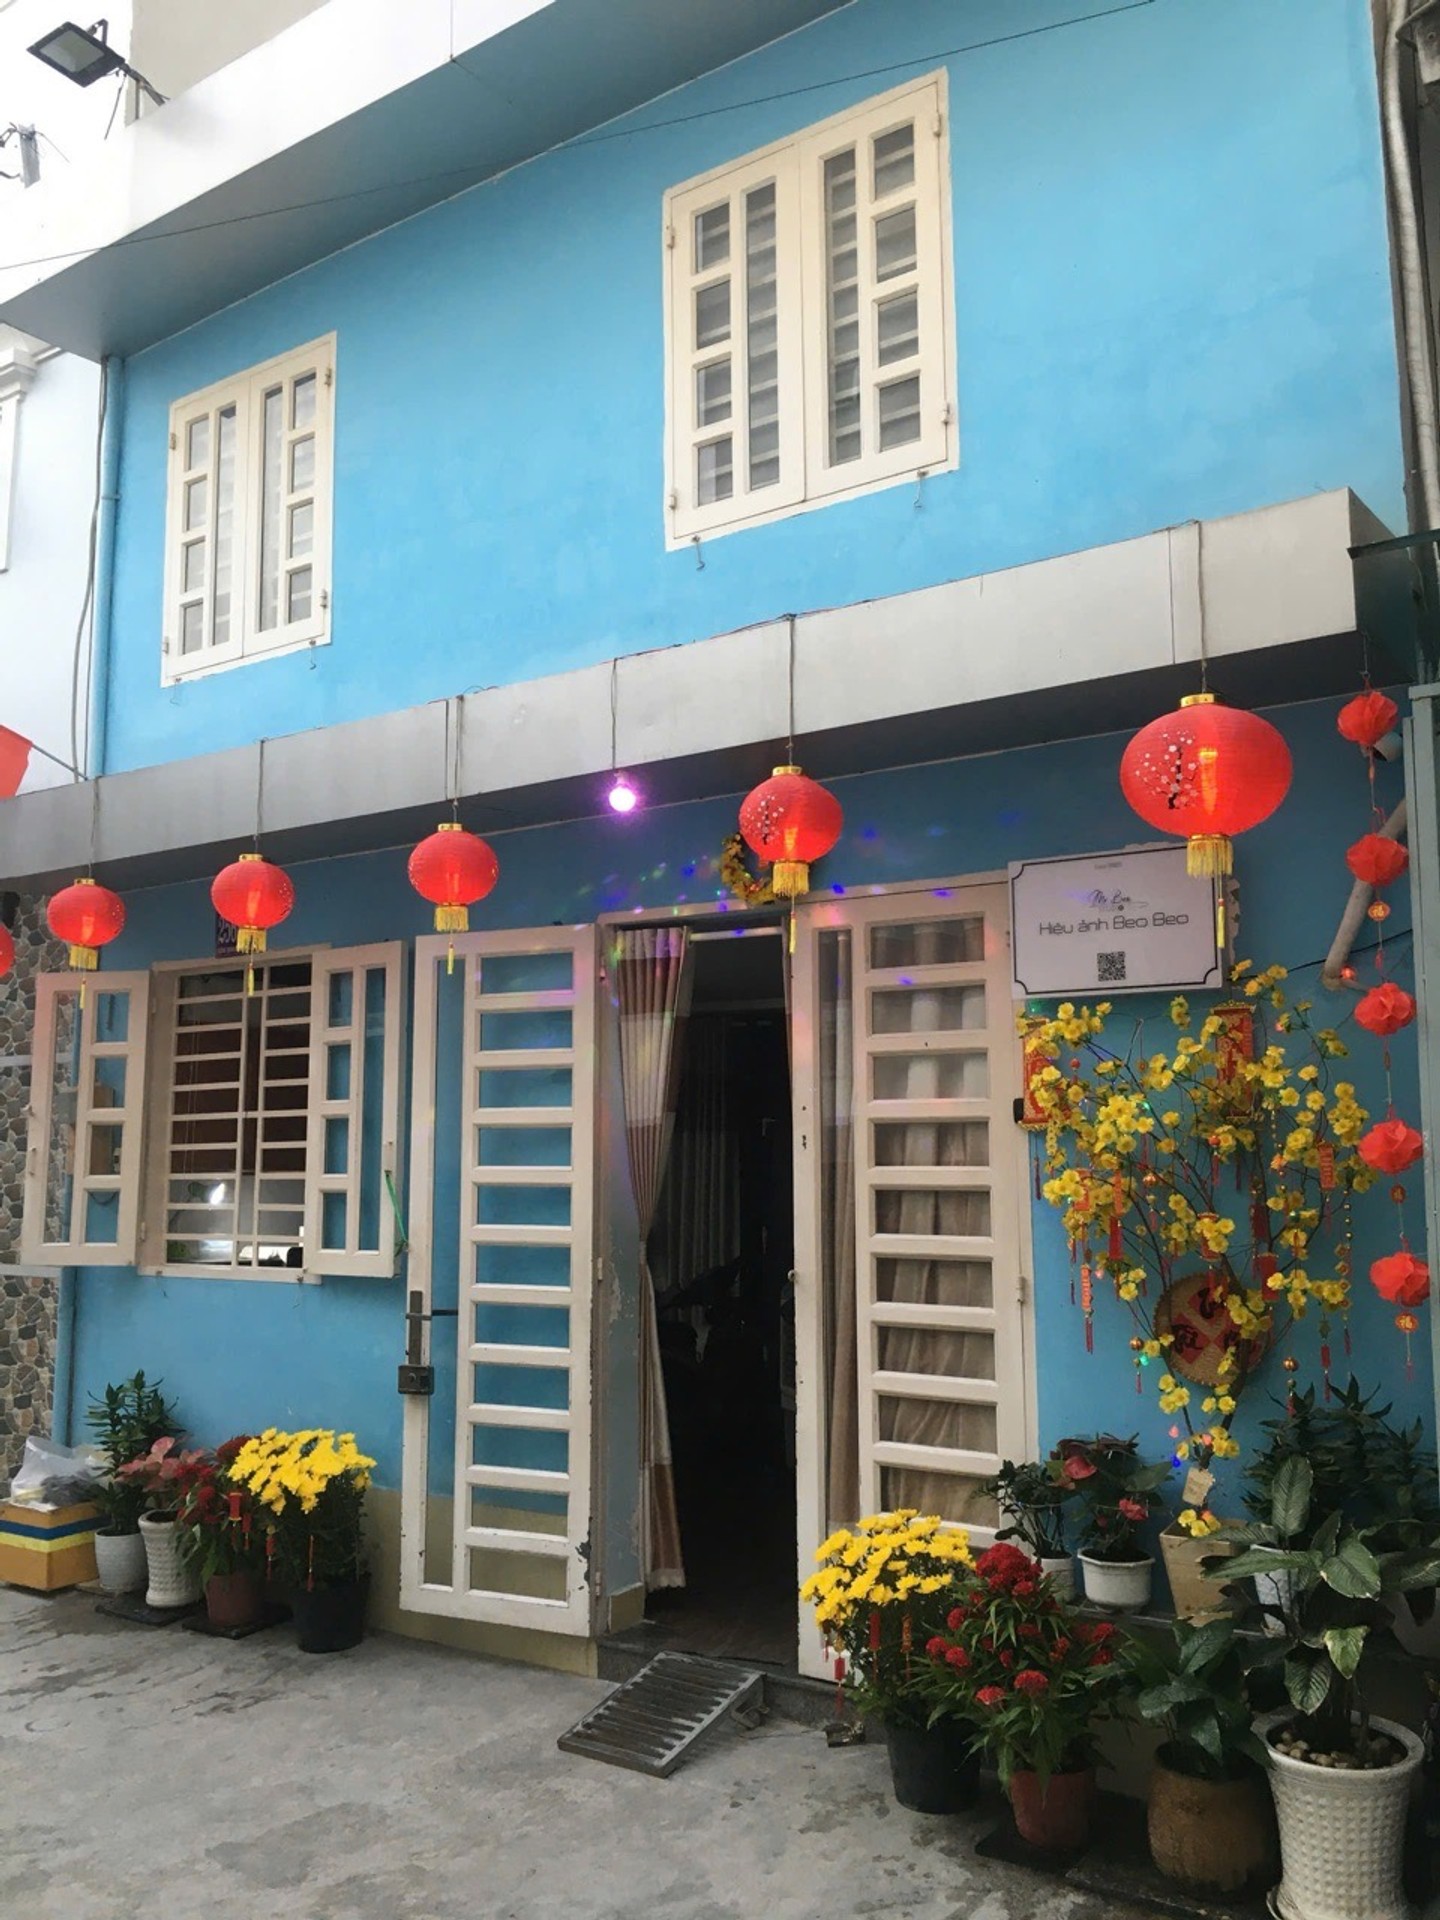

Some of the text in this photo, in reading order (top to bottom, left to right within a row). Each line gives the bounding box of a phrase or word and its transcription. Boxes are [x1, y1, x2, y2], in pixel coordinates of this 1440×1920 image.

[1039, 912, 1189, 936] Hiệu ảnh Beo Beo
